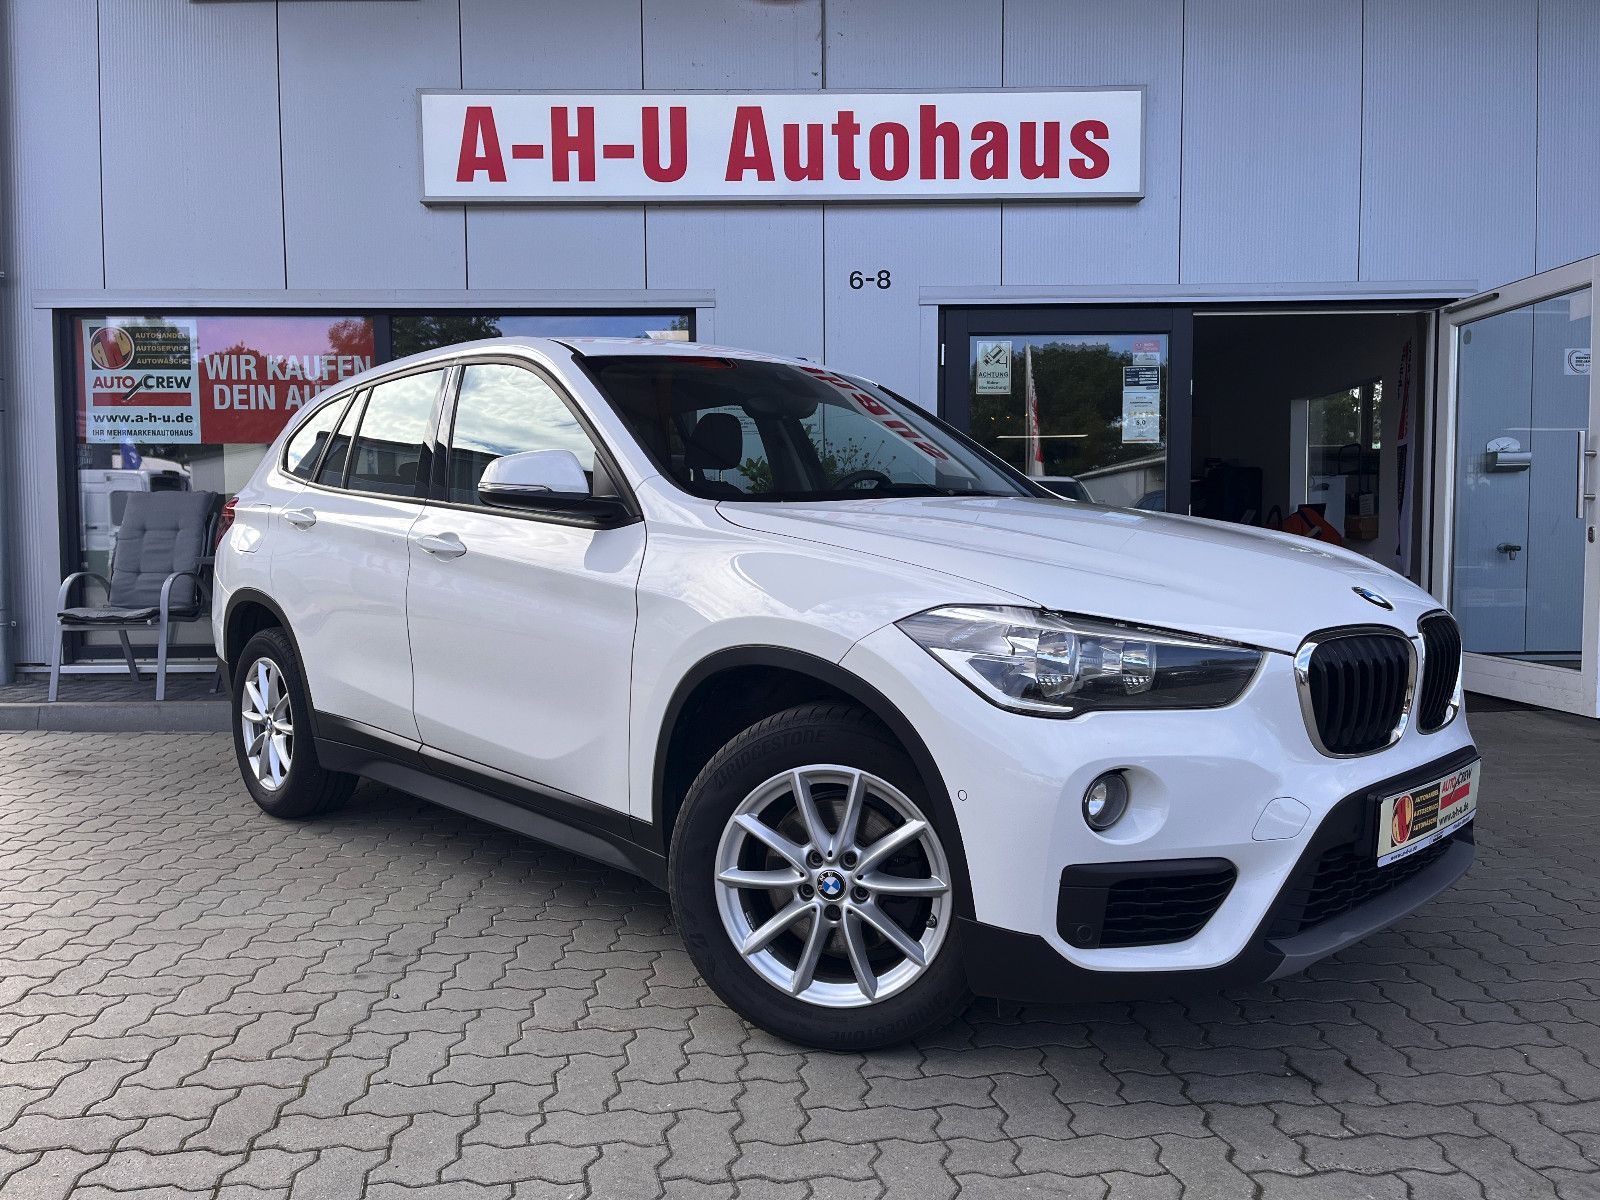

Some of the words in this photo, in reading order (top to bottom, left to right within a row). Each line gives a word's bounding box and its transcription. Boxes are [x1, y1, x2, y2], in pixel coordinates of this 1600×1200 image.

[456, 106, 688, 182] A-H-U
[725, 104, 1110, 182] Autohaus
[849, 270, 892, 290] 6-8
[205, 354, 257, 380] WIR
[266, 354, 371, 380] KAUFEN
[213, 384, 276, 410] DEIN
[93, 413, 193, 423] www.a-h-u.de
[92, 429, 104, 437] IHR
[106, 429, 193, 437] MEHRMARKENAUTOHAUS
